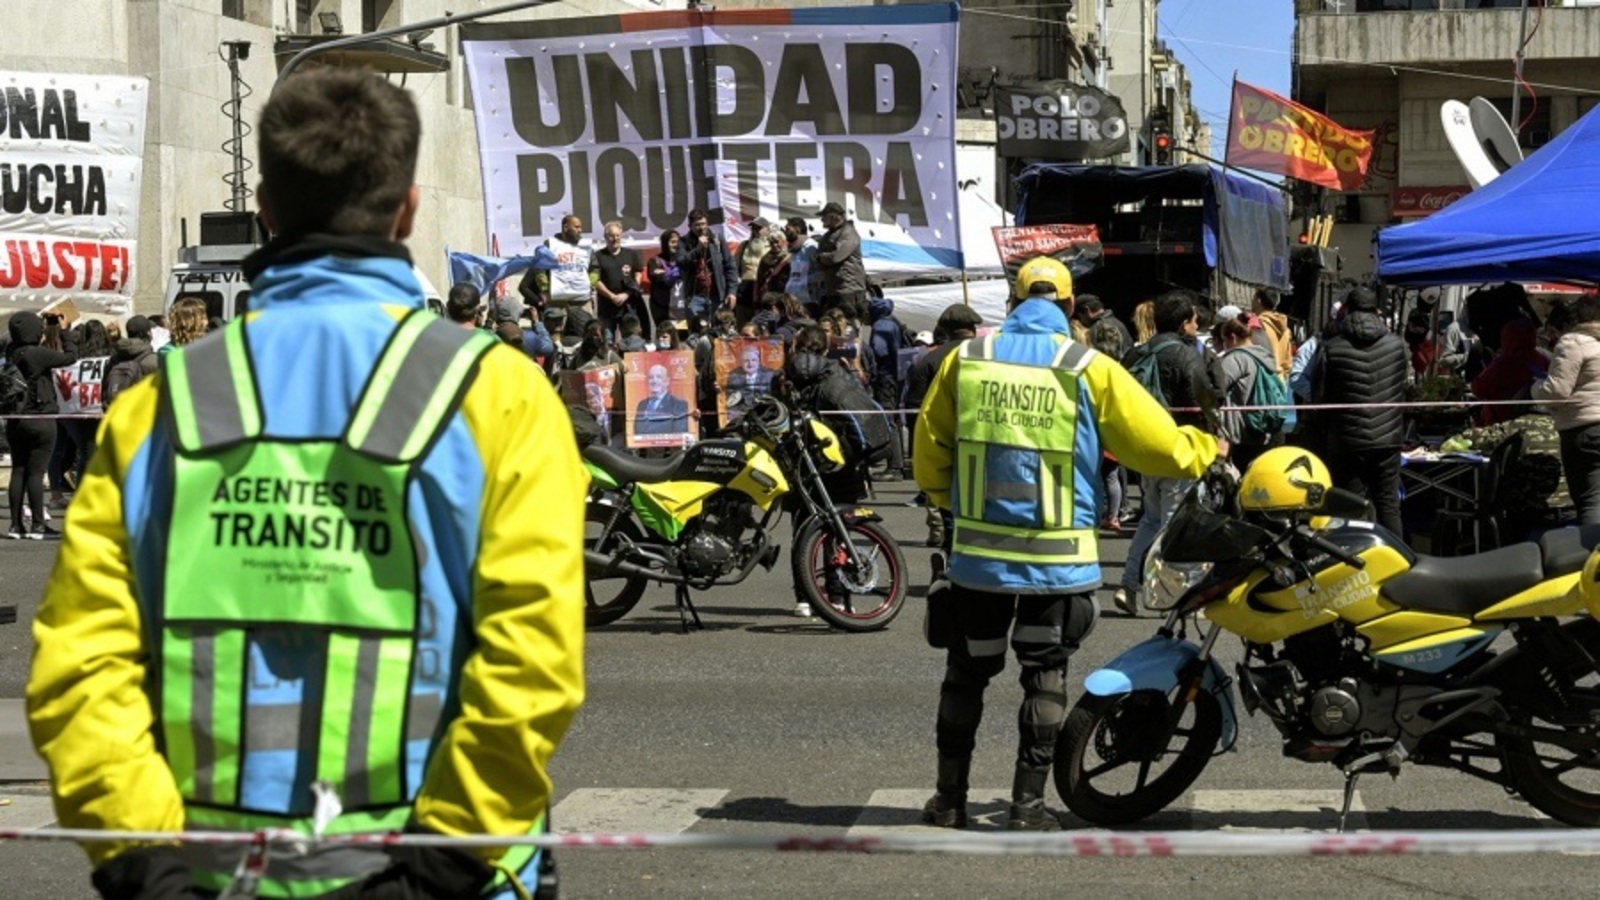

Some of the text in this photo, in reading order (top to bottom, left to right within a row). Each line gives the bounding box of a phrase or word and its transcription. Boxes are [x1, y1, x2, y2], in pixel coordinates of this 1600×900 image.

[505, 42, 922, 147] UNIDAD
[1011, 94, 1101, 118] POLO
[0, 87, 90, 142] NAL
[999, 116, 1126, 140] OBRERO
[0, 163, 106, 215] UCHA
[516, 142, 928, 237] PIQUETERA
[981, 380, 1057, 414] TRANSITO
[977, 409, 1054, 429] DE LA CIUDAD
[213, 477, 388, 512] AGENTES DE
[211, 513, 392, 557] TRANSITO
